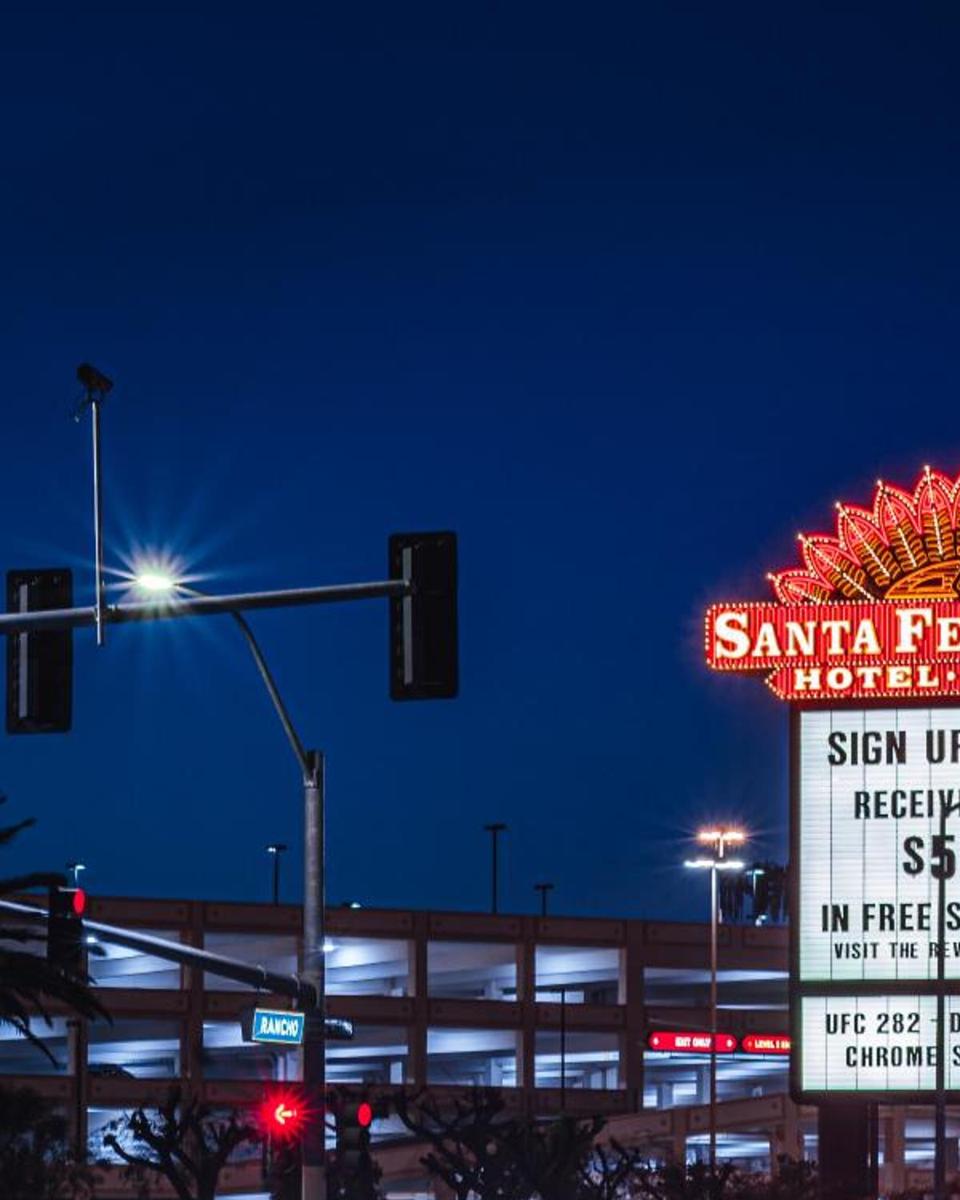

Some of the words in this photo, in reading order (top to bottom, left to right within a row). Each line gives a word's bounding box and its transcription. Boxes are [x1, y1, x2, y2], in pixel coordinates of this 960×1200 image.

[714, 611, 882, 659] SANTA
[794, 666, 940, 691] HOTEL
[827, 730, 907, 766] SIGN
[821, 904, 849, 933] IN
[862, 903, 932, 932] FREE
[834, 942, 880, 959] VISIT
[889, 941, 918, 959] THE
[260, 1016, 299, 1038] RANCHO
[825, 1013, 866, 1035] UFC
[876, 1012, 921, 1034] 282
[845, 1046, 938, 1068] CHROME
